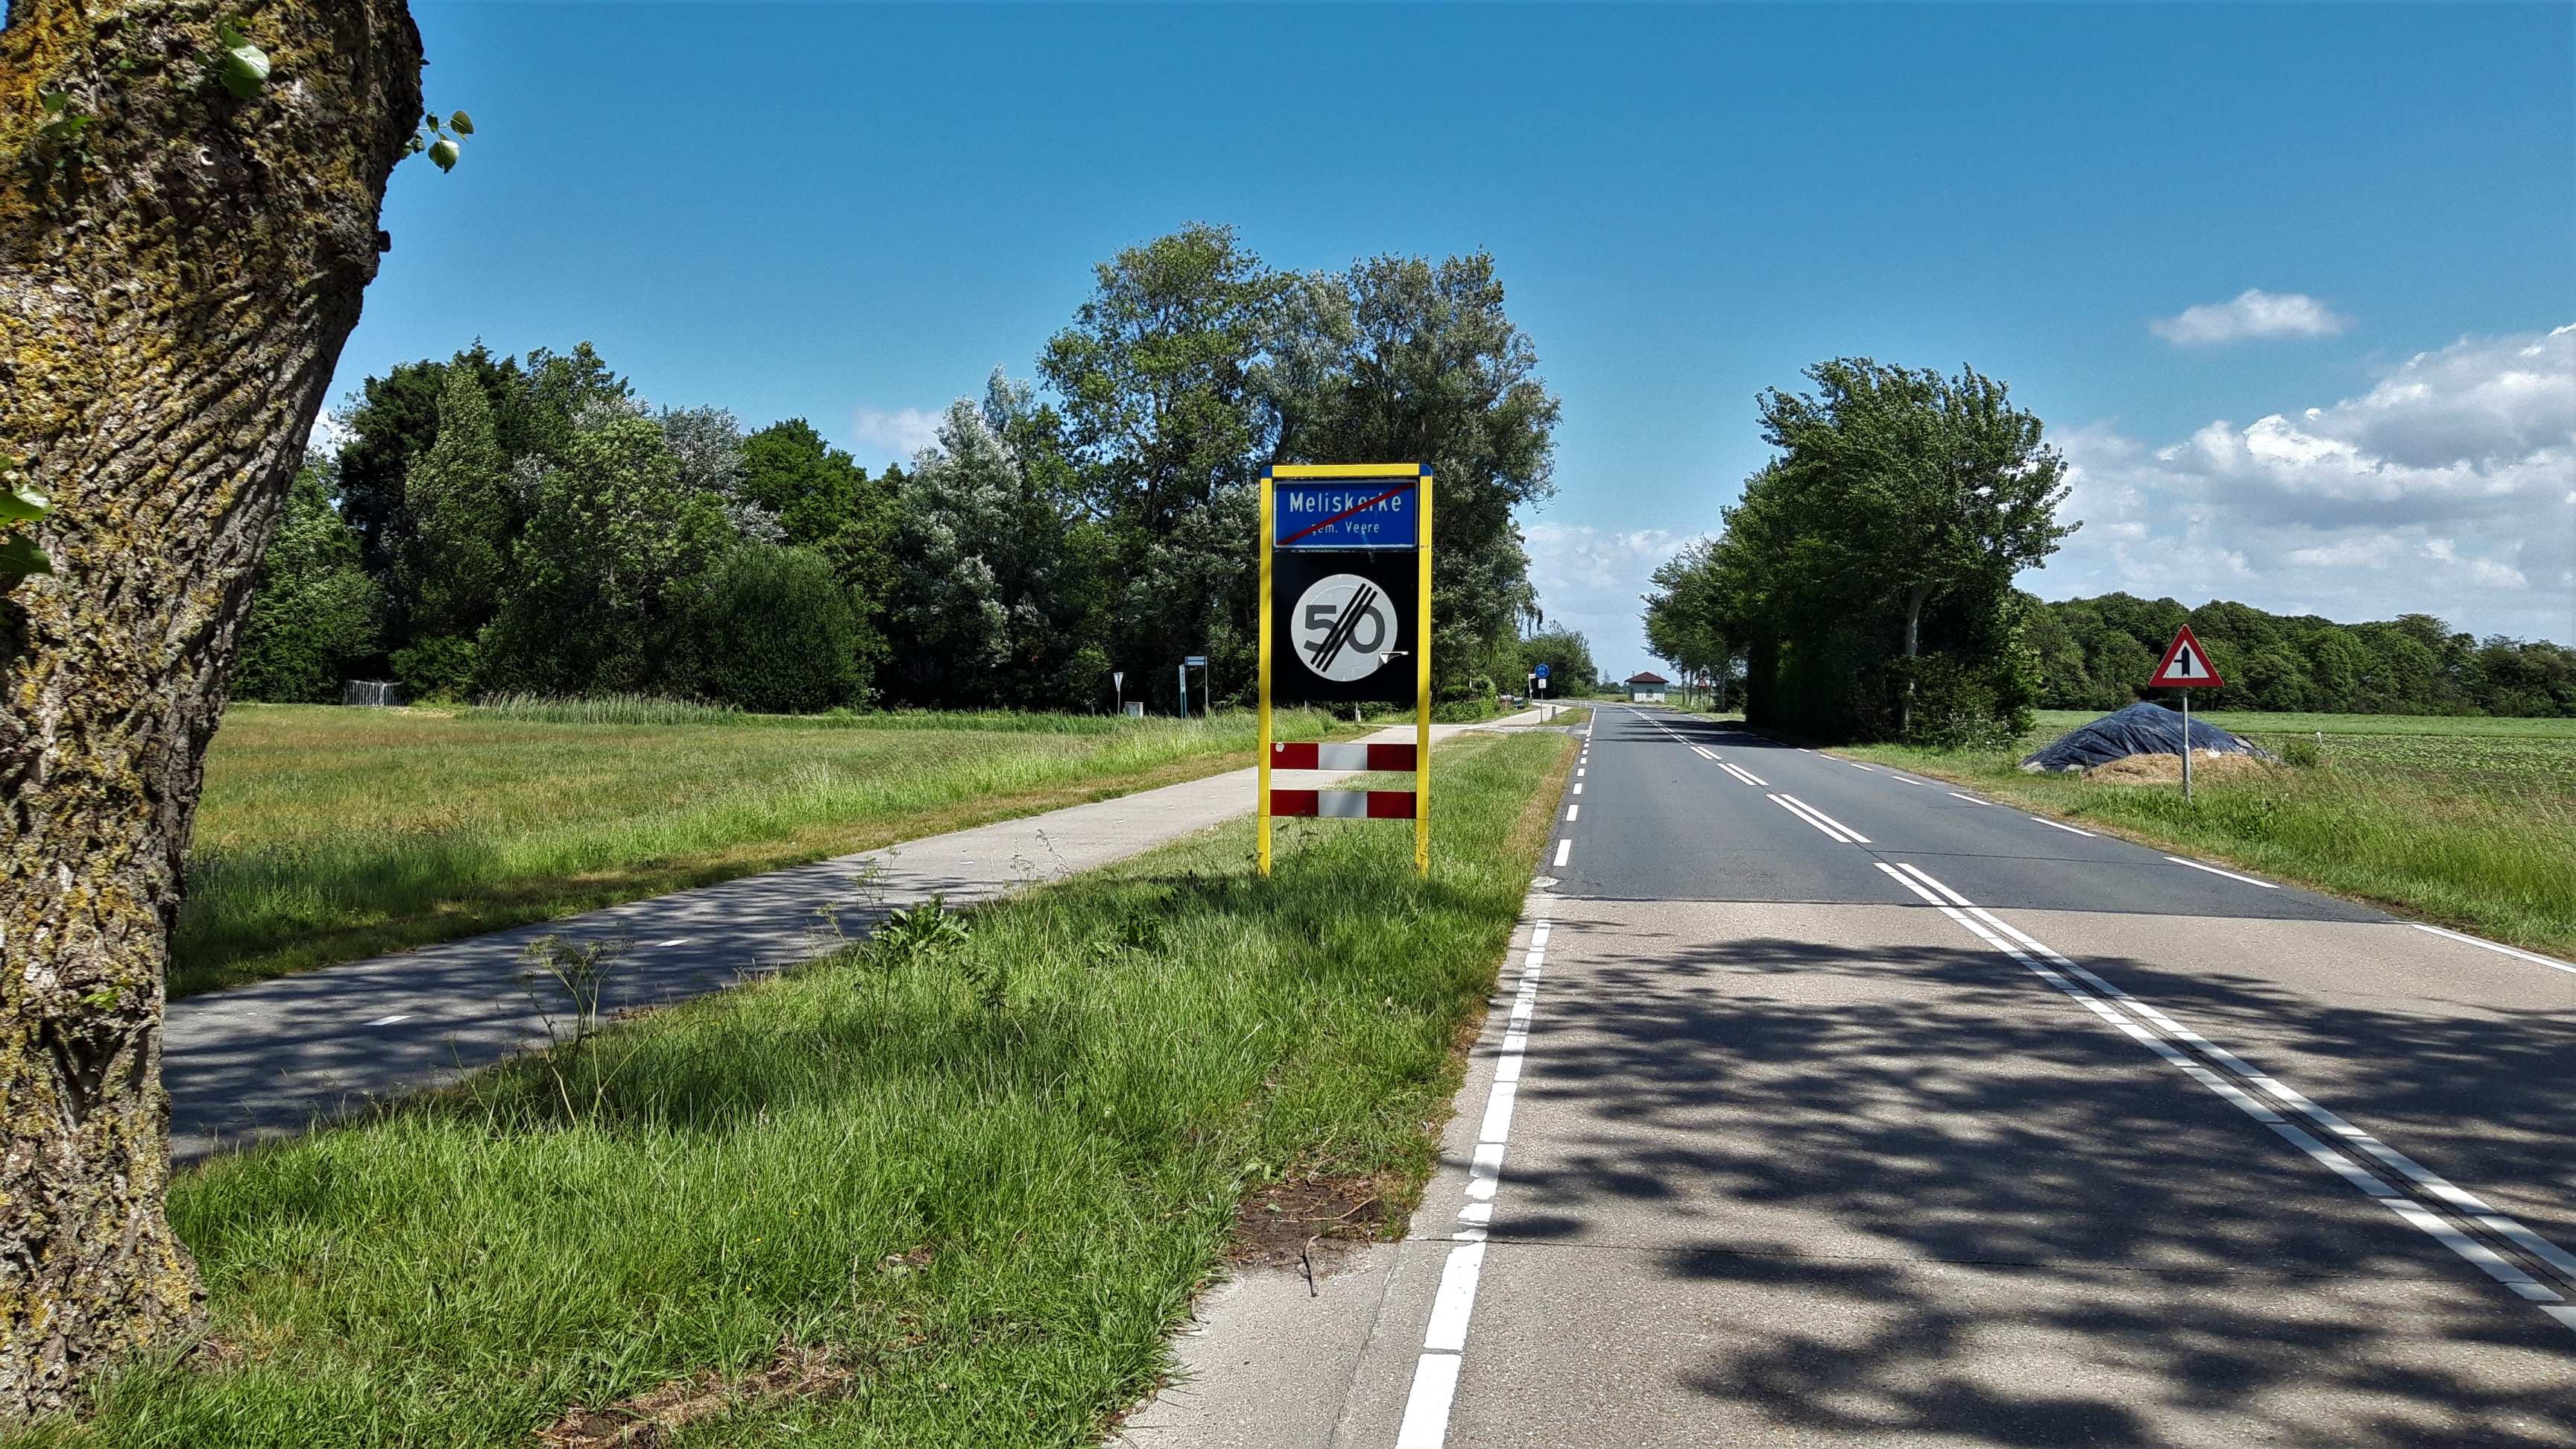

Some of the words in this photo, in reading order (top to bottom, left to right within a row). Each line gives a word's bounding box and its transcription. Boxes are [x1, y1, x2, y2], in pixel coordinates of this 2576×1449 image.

[1289, 492, 1401, 513] Meliskerke
[1345, 522, 1380, 533] Veere
[1304, 604, 1386, 654] 50
